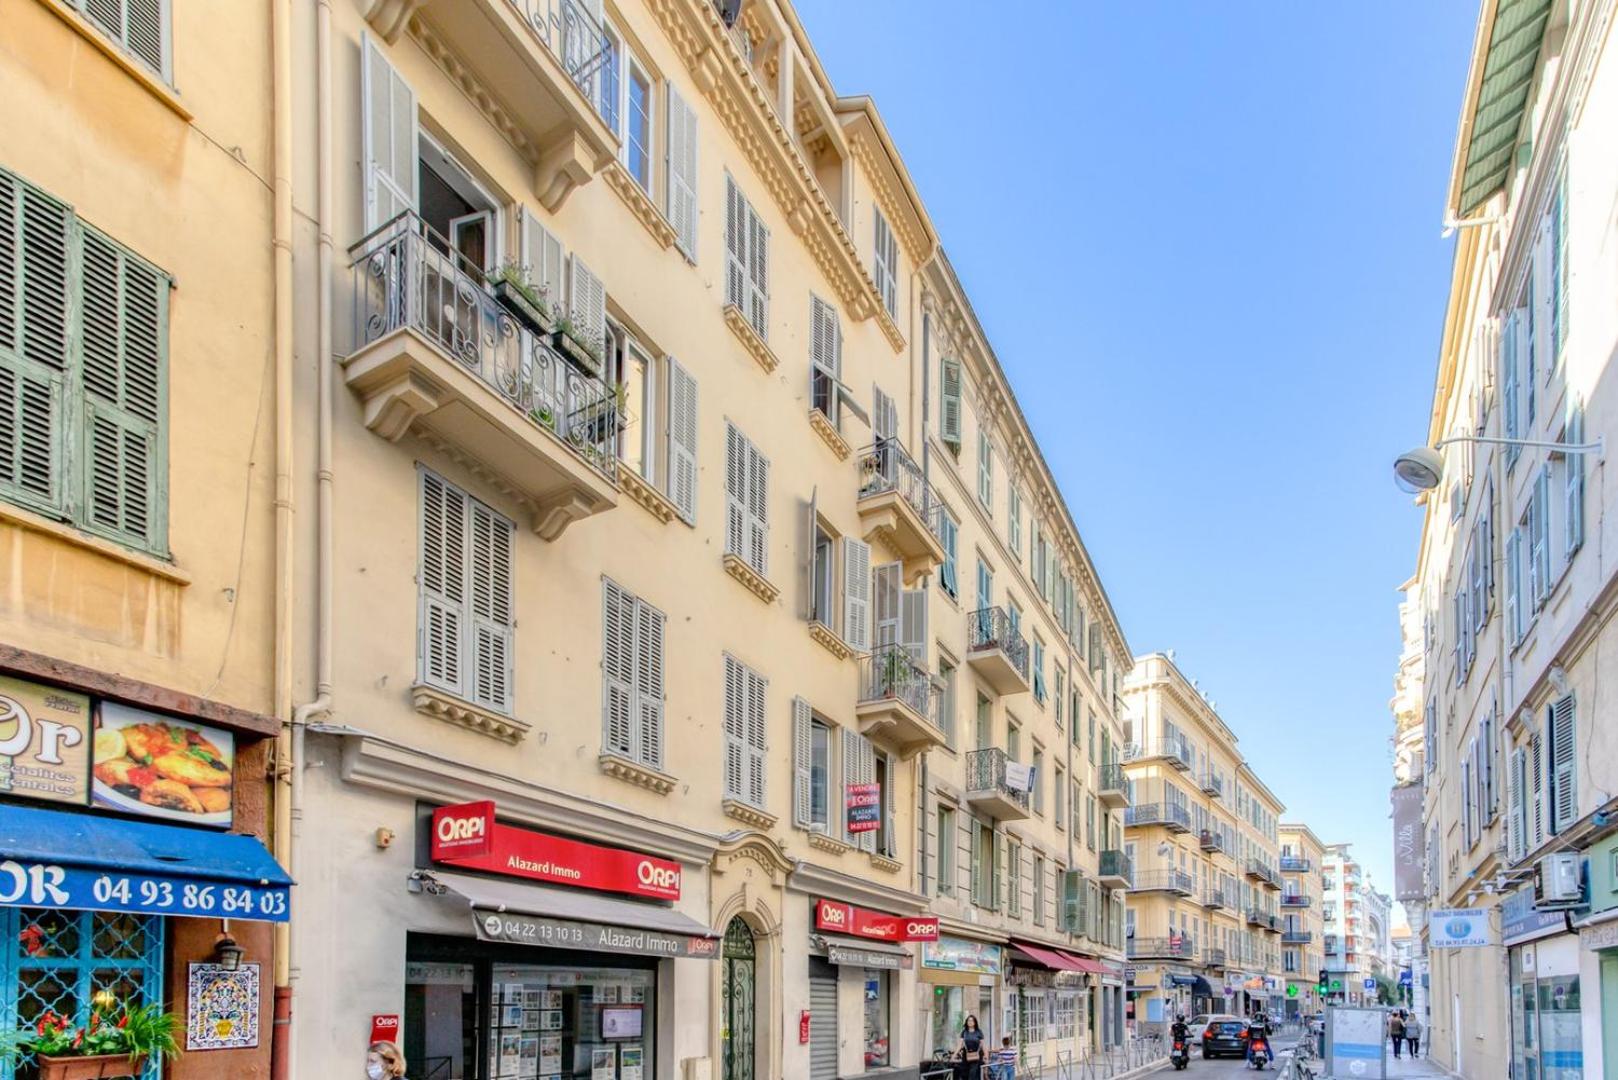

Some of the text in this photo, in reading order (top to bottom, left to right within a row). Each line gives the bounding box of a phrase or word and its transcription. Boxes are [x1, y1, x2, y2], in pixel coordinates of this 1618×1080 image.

[437, 816, 485, 842] ORPI
[507, 855, 581, 880] Alazard Immo
[637, 860, 681, 890] ORPI
[93, 875, 286, 915] 04 93 86 84 03
[822, 904, 845, 924] ORPI
[505, 921, 520, 935] 04
[522, 923, 536, 937] 22
[541, 925, 552, 939] 13
[556, 927, 568, 940] 10
[572, 929, 583, 941] 13
[599, 928, 644, 949] Alazard
[646, 935, 678, 953] Immo
[906, 922, 937, 935] ORPI
[1366, 980, 1373, 988] P
